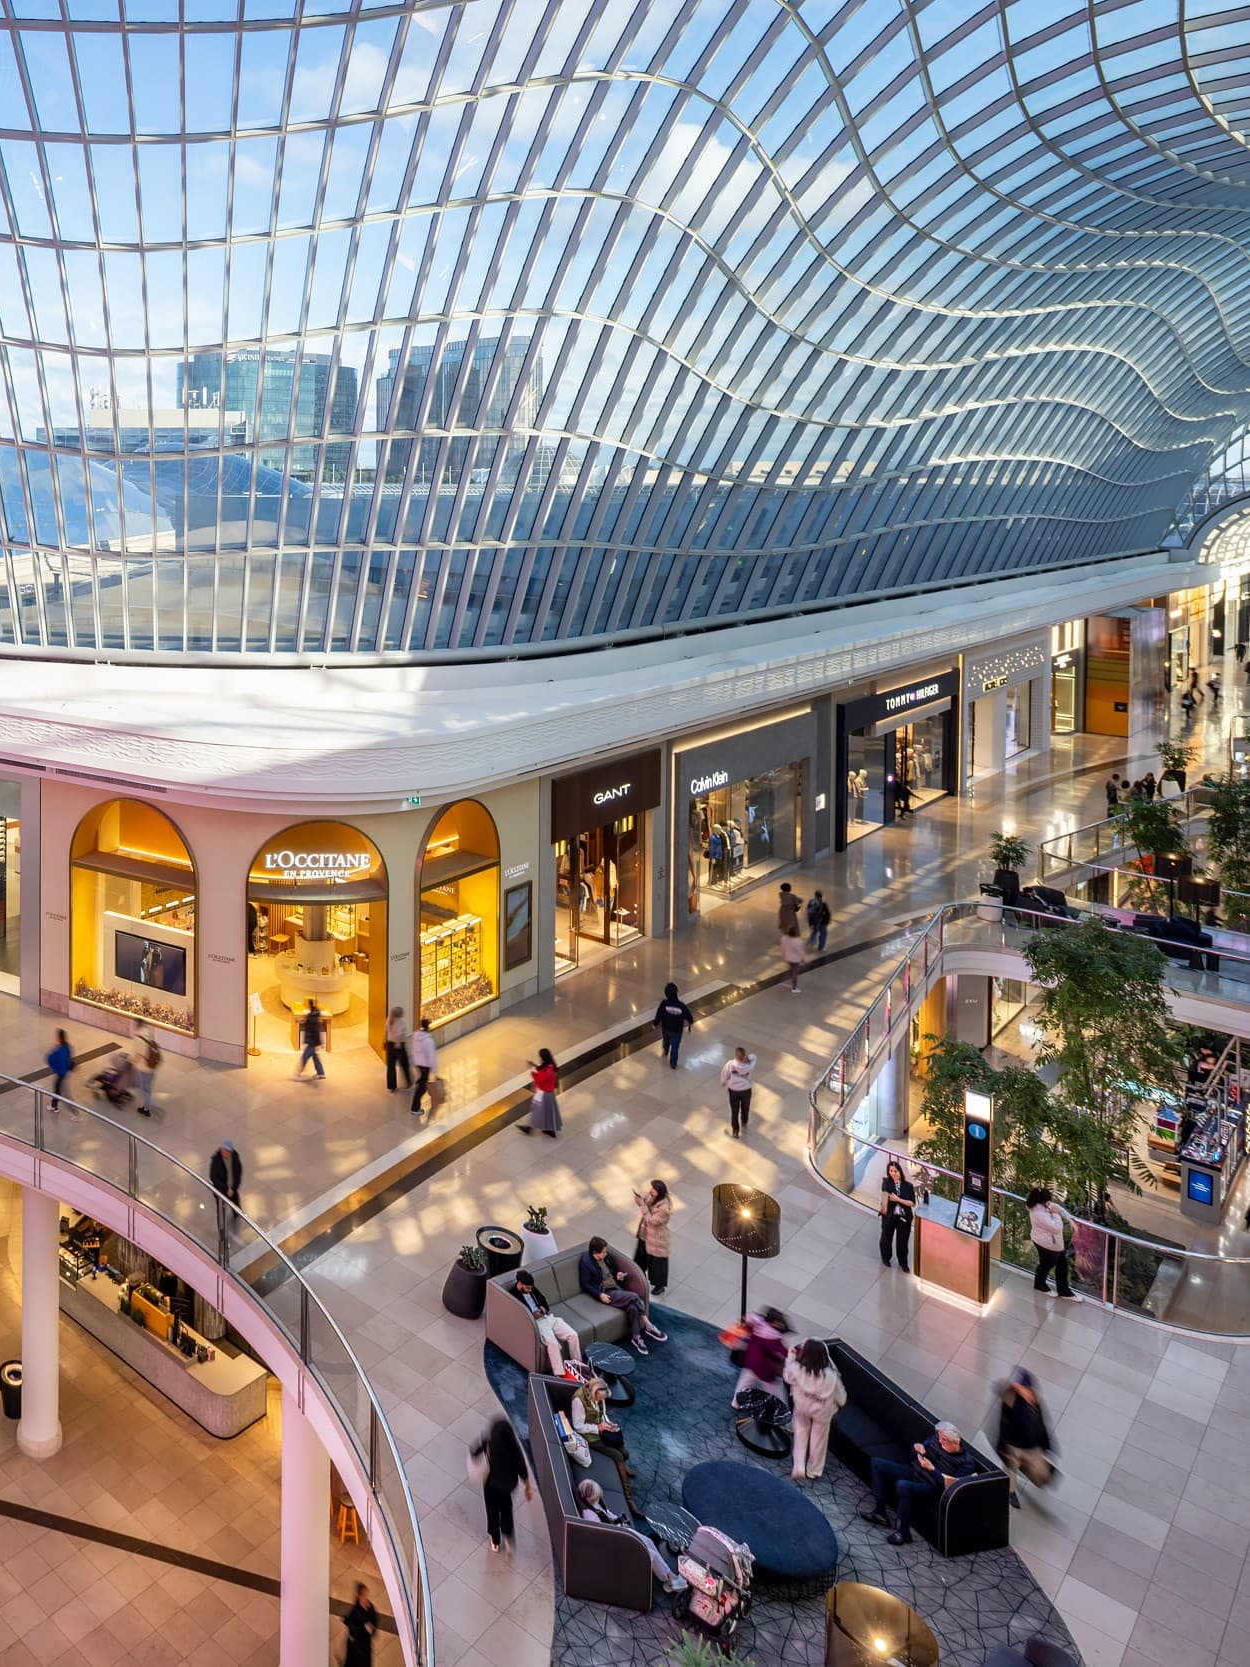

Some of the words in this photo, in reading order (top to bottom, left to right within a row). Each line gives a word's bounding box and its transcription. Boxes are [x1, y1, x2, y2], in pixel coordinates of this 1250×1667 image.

[886, 693, 910, 711] TOMMY
[916, 684, 939, 700] HILFIGER
[691, 775, 712, 794] Calvin
[713, 770, 728, 787] Klein
[593, 783, 631, 805] GANT
[266, 850, 370, 868] L'OCCITANE
[284, 870, 297, 879] EN
[299, 869, 351, 878] PROVENCE
